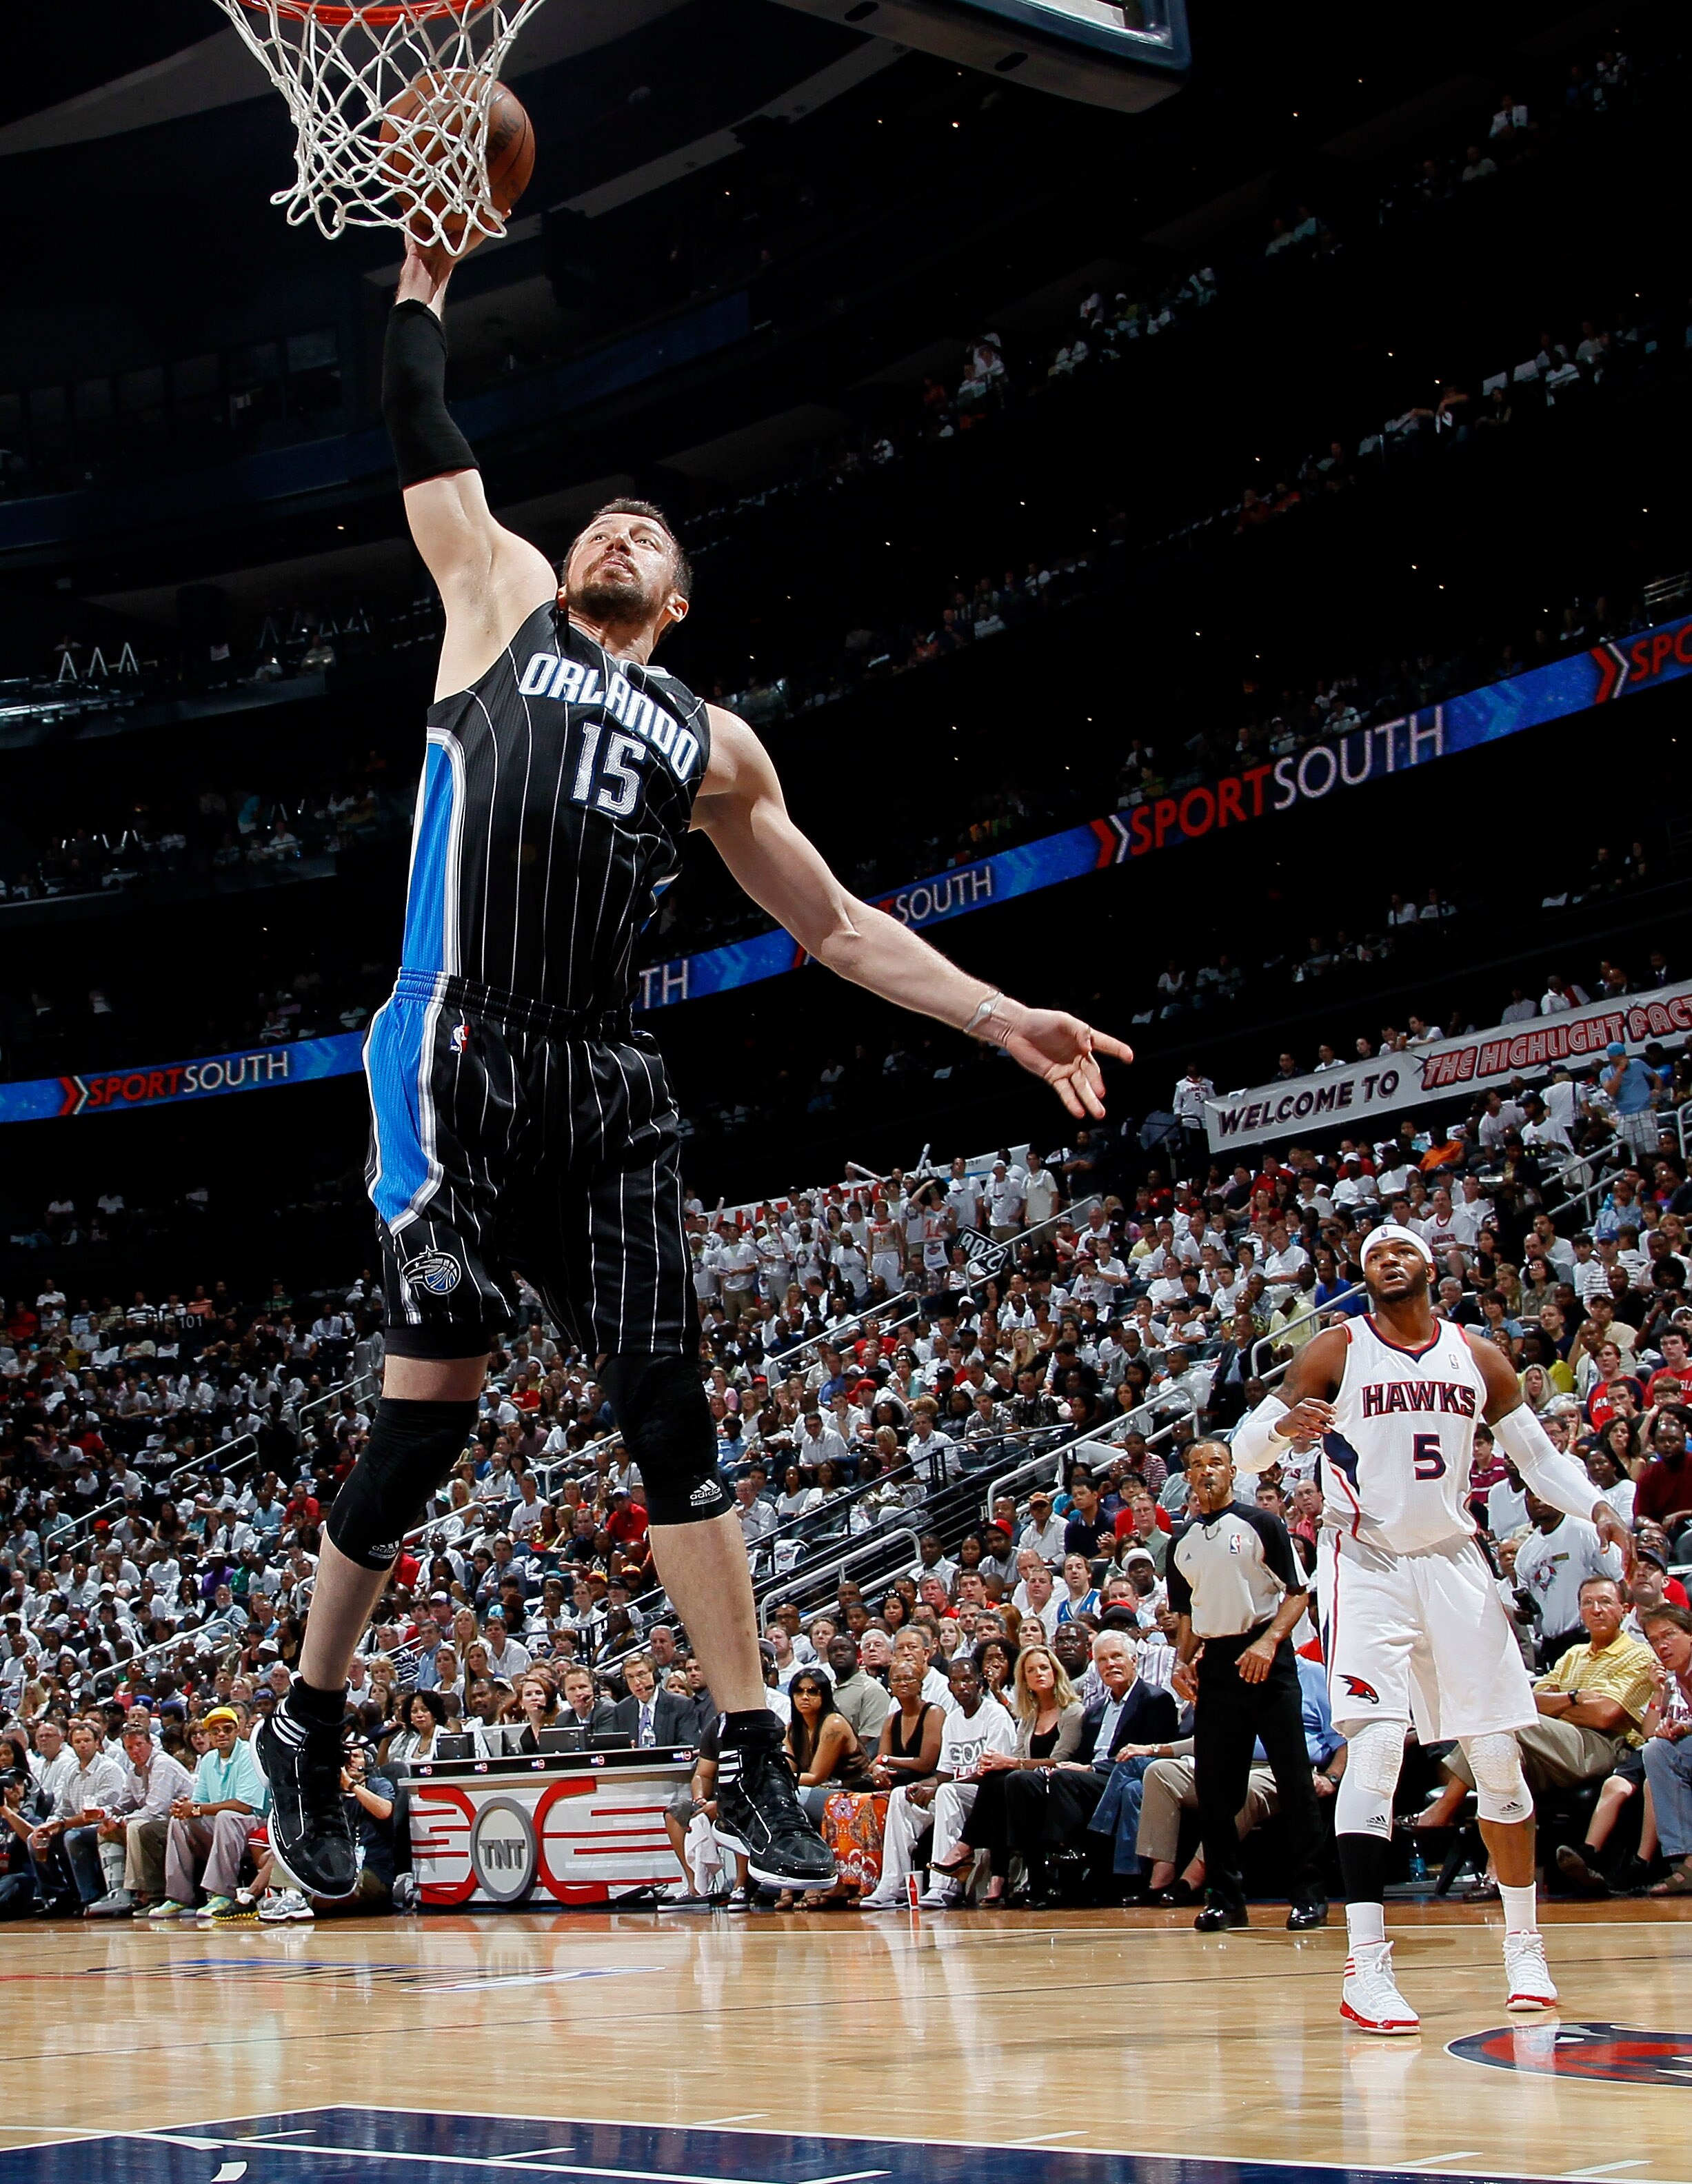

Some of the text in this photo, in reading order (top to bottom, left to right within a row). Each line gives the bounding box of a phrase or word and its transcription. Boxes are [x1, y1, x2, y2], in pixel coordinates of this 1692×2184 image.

[518, 651, 700, 782] ORLANDO
[570, 722, 647, 817] 15
[1218, 1079, 1355, 1137] WELCOME
[1361, 1069, 1400, 1103] TO
[1420, 1045, 1478, 1090] THE
[1477, 1011, 1624, 1077] HIGHLIGHT
[179, 1315, 202, 1329] 101
[1362, 1381, 1476, 1419] HAWKS
[1412, 1433, 1447, 1481] 5
[479, 1839, 526, 1870] TNT
